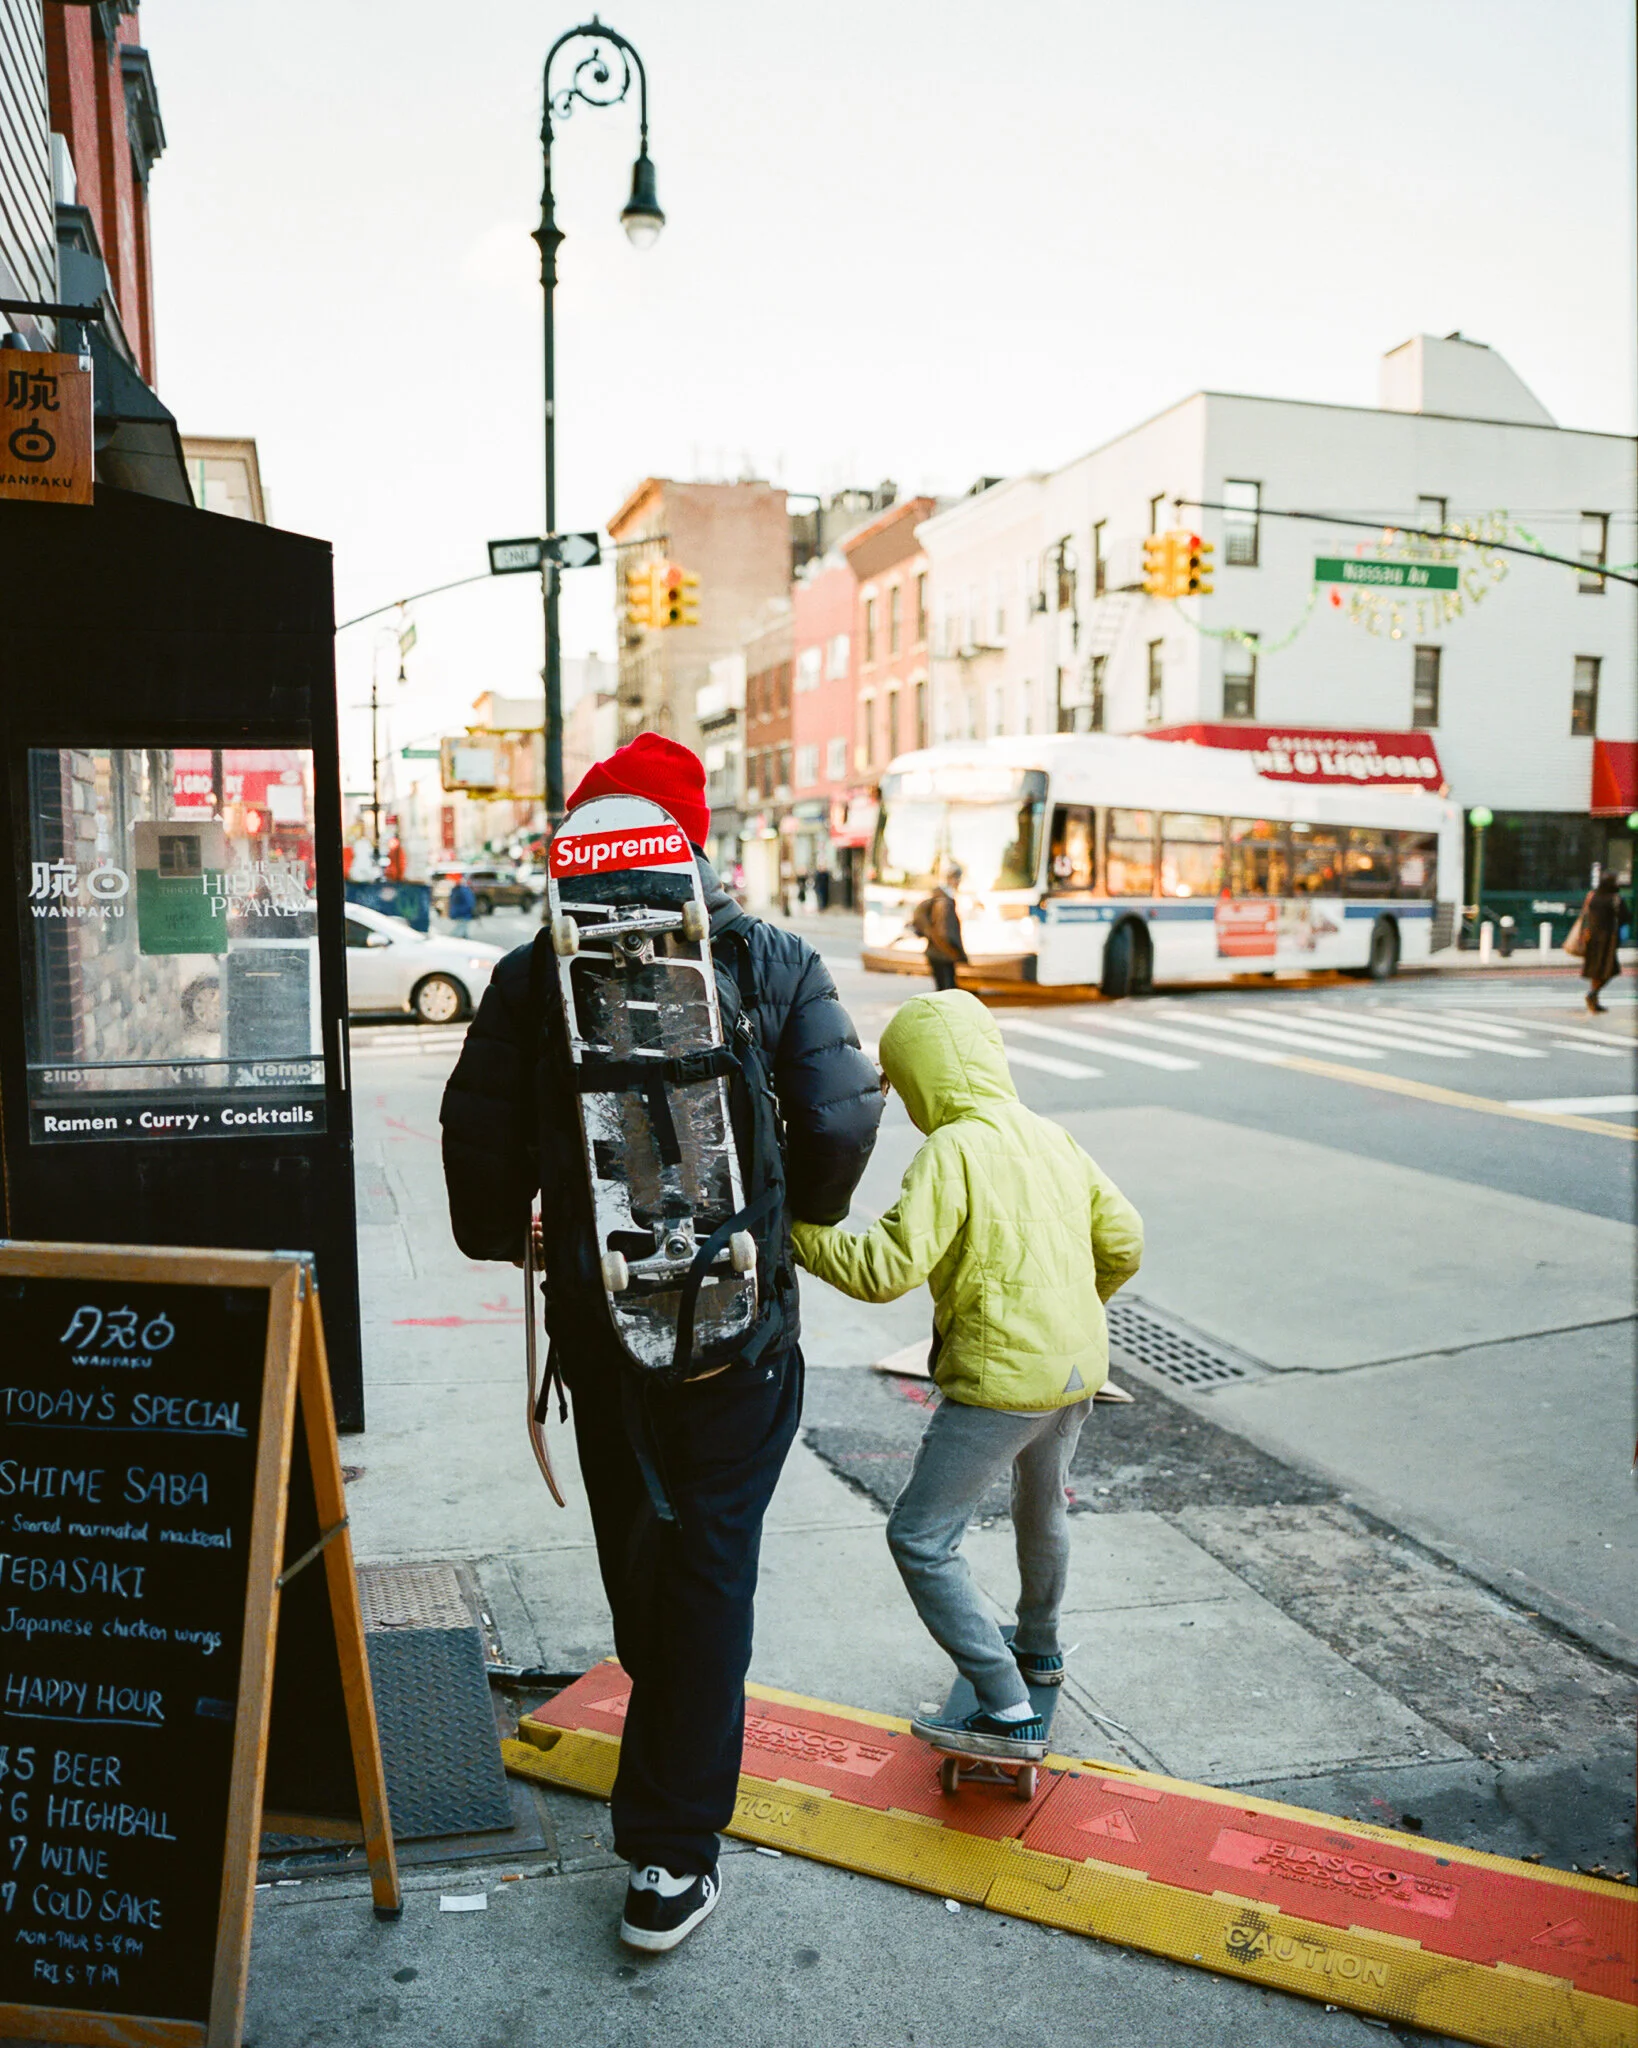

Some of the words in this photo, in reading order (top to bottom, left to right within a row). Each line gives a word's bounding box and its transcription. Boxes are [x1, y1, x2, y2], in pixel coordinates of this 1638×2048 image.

[1343, 562, 1404, 585] Nassau
[1406, 566, 1430, 586] Av
[556, 834, 683, 870] Supreme
[202, 874, 306, 895] HIDDEN
[31, 905, 125, 918] WANPAKU
[210, 896, 299, 918] PEARL
[44, 1116, 118, 1132] Ramen
[139, 1112, 199, 1130] Curry
[220, 1106, 314, 1125] Cocktails
[72, 1355, 153, 1368] WANPAKU
[0, 1385, 115, 1421] TODAY'S
[131, 1394, 248, 1432] SPECIAL
[0, 1460, 105, 1503] SHIME
[124, 1466, 209, 1505] SABA
[12, 1513, 61, 1534] Seared
[69, 1521, 149, 1542] marinated
[1, 1607, 93, 1641] Japanese
[102, 1617, 167, 1641] chicken
[174, 1629, 222, 1655] wings
[5, 1673, 87, 1714] HAPPY
[97, 1684, 165, 1720] HOUR
[744, 1732, 848, 1763] RODUCTS
[745, 1720, 848, 1752] ELASCO
[53, 1749, 122, 1787] BEER
[47, 1794, 177, 1840] HIGHBALL
[41, 1841, 109, 1879] WINE
[1252, 1855, 1411, 1901] PRODUCTS
[1267, 1843, 1402, 1886] ELASCO
[33, 1884, 92, 1920] COLD
[99, 1889, 162, 1929] SAKE
[125, 1937, 144, 1958] PM
[1224, 1924, 1390, 1989] CAUTION
[34, 1959, 60, 1984] FRI
[101, 1963, 120, 1988] PM
